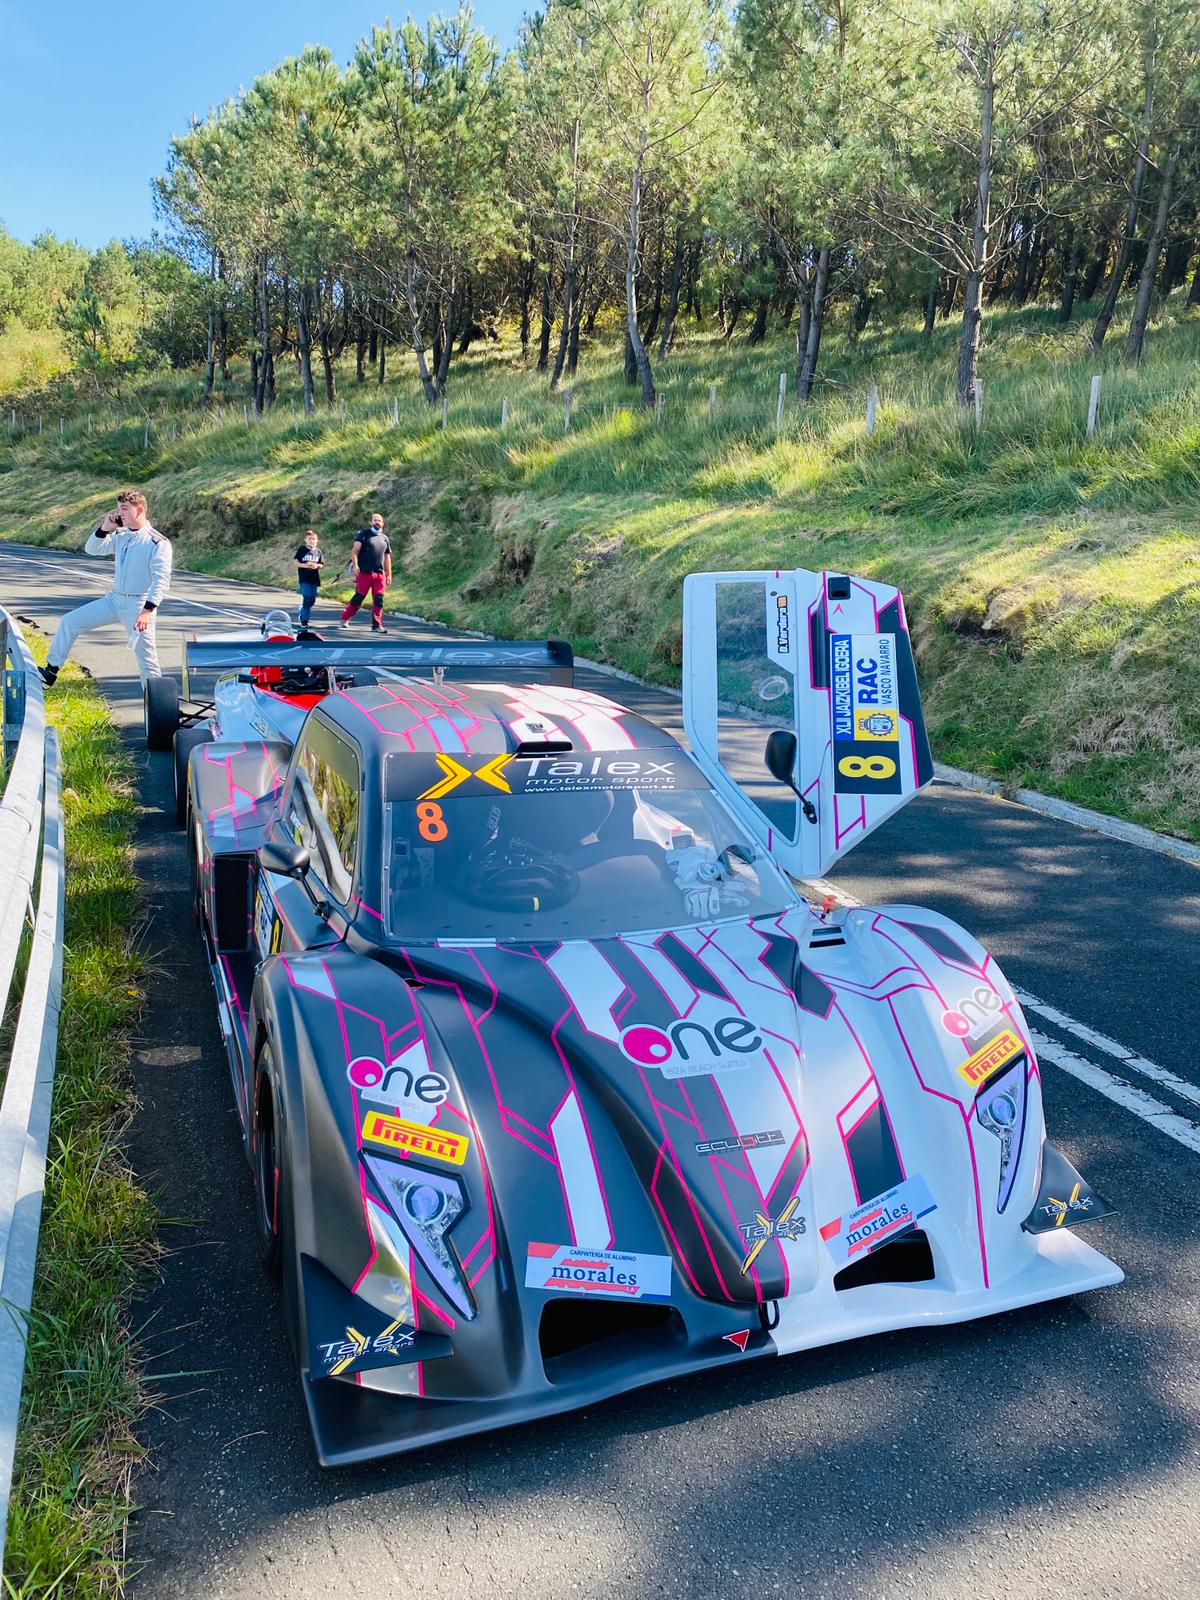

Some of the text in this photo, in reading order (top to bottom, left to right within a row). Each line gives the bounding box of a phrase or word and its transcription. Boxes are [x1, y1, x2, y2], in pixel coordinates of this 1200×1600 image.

[309, 647, 543, 662] Talex
[856, 658, 879, 704] RAC
[879, 639, 893, 705] VASCO NAVARRO
[835, 672, 852, 717] JAIZKIBEL
[515, 756, 676, 777] Talex
[838, 755, 896, 780] 8
[524, 784, 675, 793] www.talexmotorsport.es
[526, 776, 677, 786] motor sport
[416, 801, 448, 842] 8
[964, 1034, 1017, 1082] PIRELLI
[372, 1118, 460, 1158] PIRELLI
[1039, 1196, 1092, 1214] Talex
[739, 1218, 804, 1238] Talex
[846, 1202, 909, 1247] morales
[551, 1265, 638, 1286] morales
[319, 1330, 416, 1358] Talex
[323, 1340, 416, 1364] motor sport
